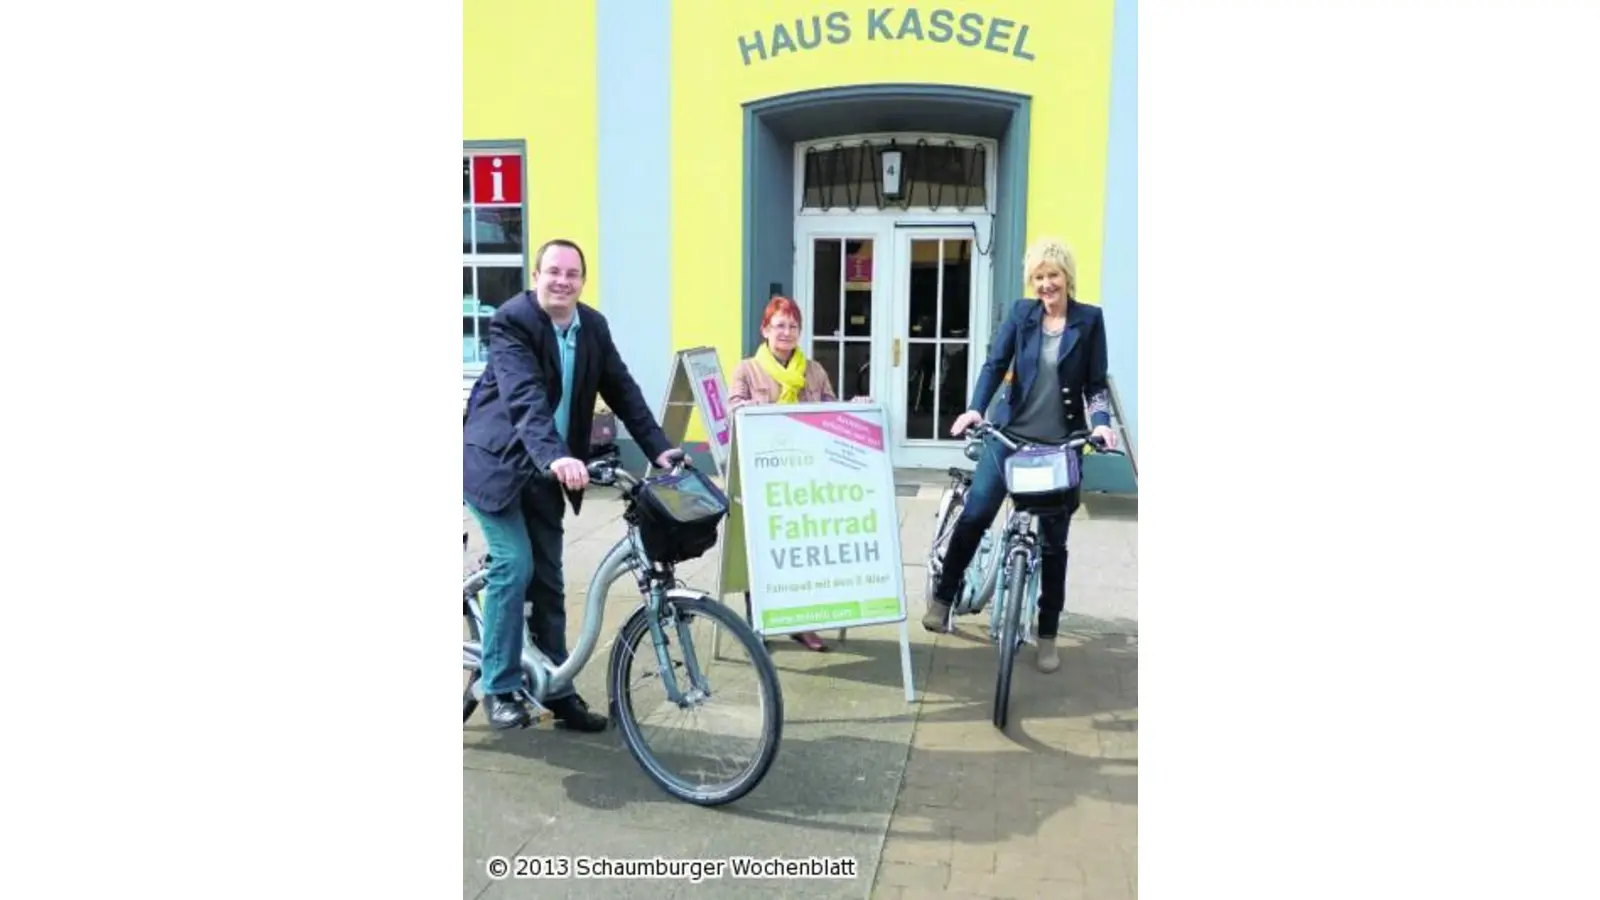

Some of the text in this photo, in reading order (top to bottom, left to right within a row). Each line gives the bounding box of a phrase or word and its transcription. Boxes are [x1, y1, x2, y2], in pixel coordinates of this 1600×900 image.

[737, 8, 1036, 65] HAUS KASSEL
[490, 157, 505, 202] i
[886, 164, 896, 177] 4
[765, 479, 875, 507] Elektro-
[768, 508, 878, 540] Fahrrad
[770, 540, 880, 569] VERLEIH
